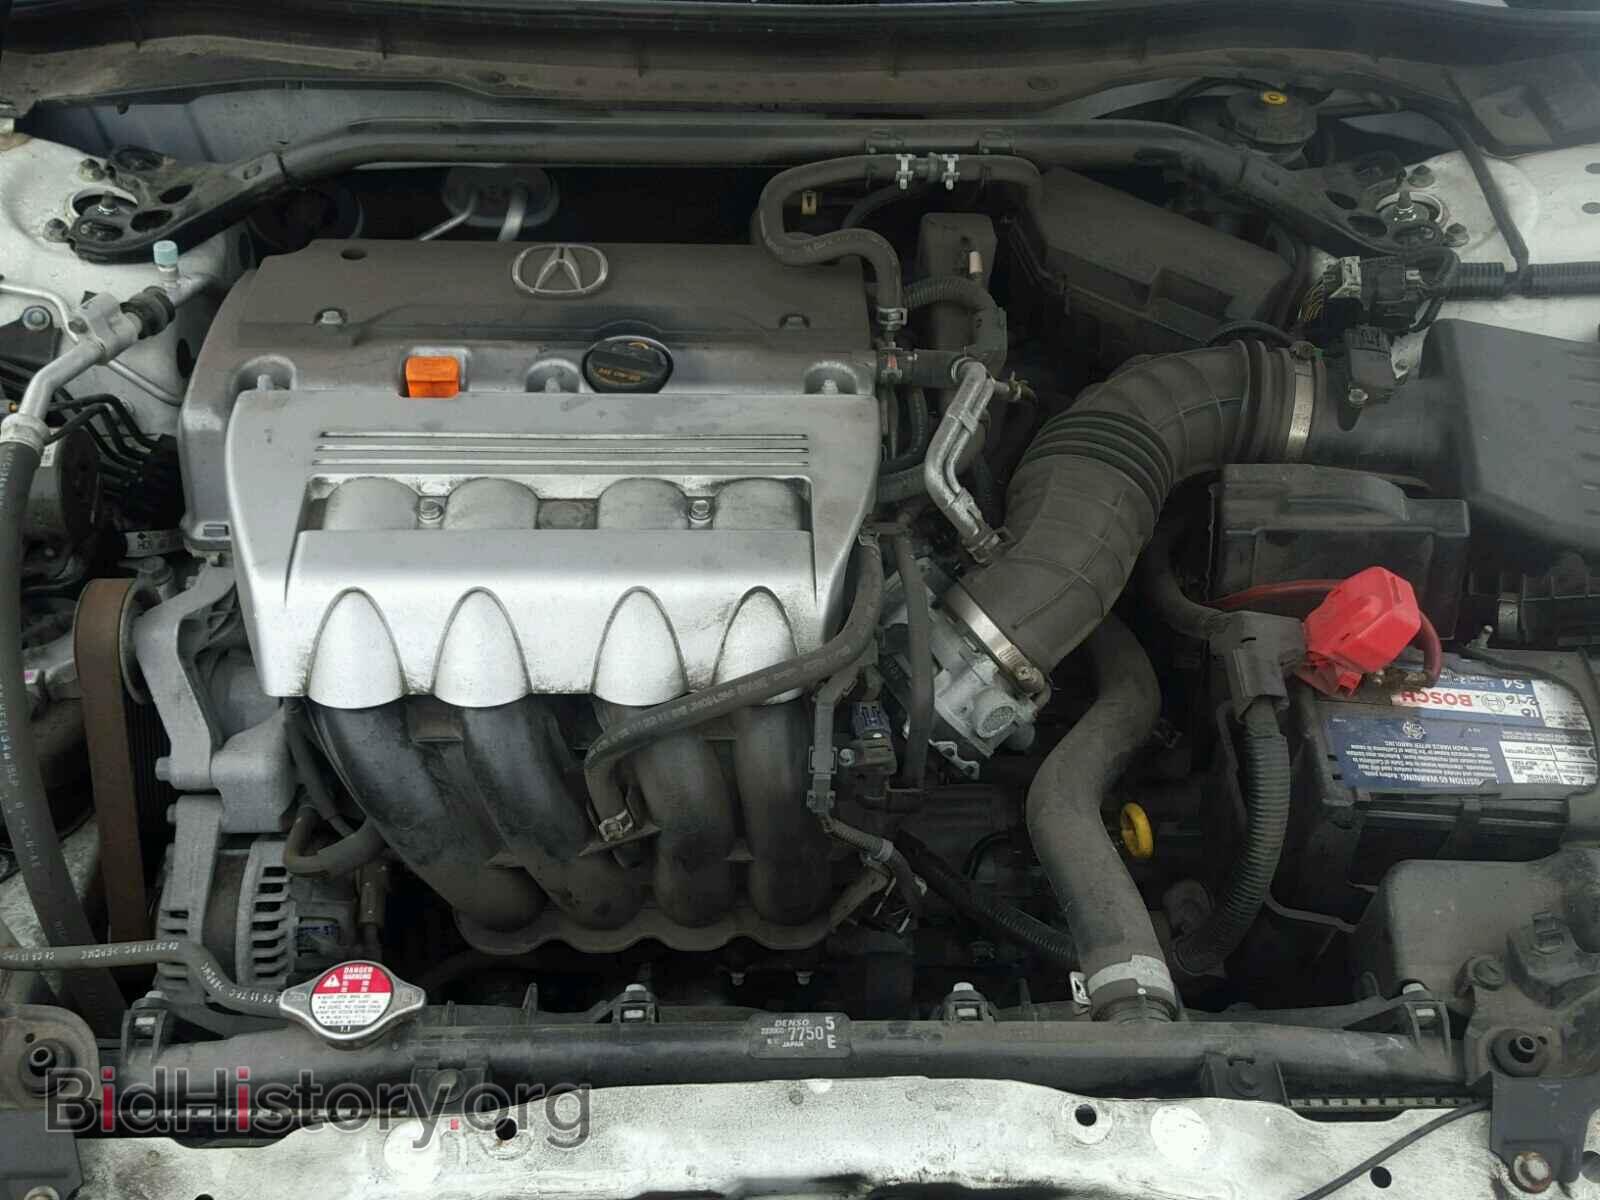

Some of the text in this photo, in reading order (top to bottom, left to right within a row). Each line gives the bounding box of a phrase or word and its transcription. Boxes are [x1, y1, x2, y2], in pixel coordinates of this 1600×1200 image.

[1400, 691, 1473, 707] BOSCH
[774, 1019, 810, 1027] DENSO
[825, 1016, 835, 1030] 5
[788, 1026, 824, 1040] 7750
[827, 1034, 837, 1049] E
